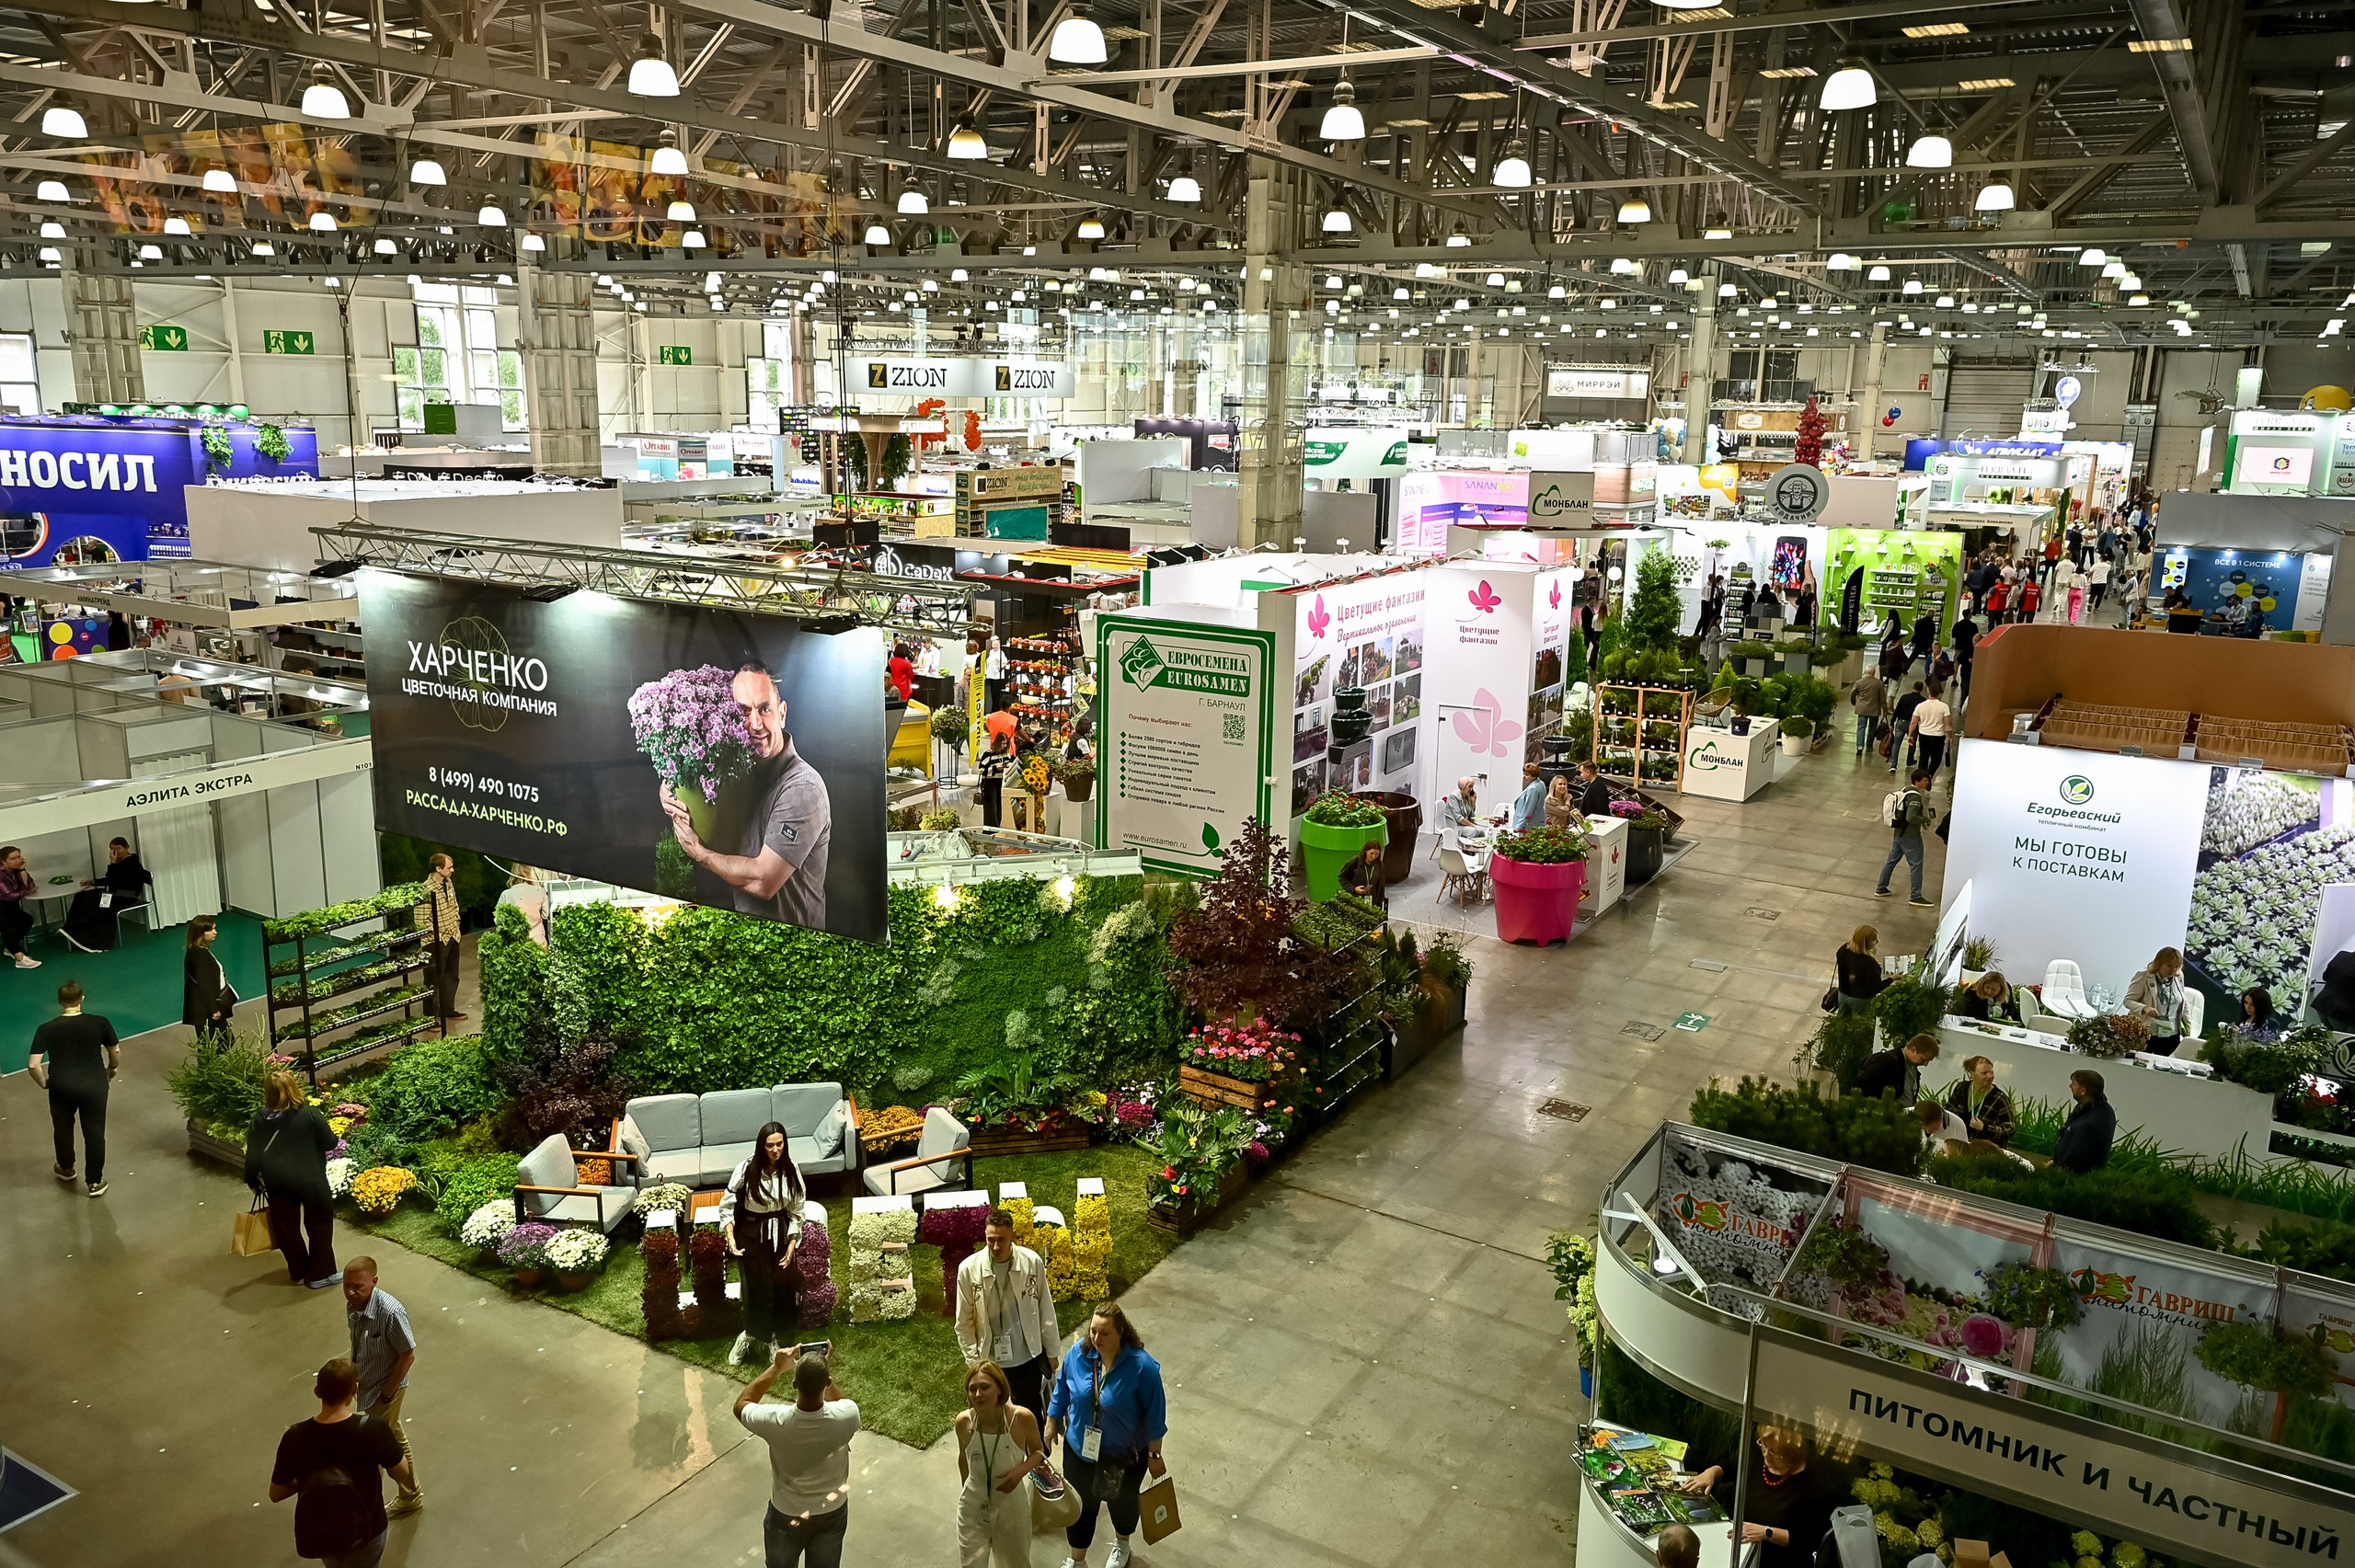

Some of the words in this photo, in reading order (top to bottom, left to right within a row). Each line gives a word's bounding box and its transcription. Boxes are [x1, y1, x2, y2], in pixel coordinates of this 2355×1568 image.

[892, 368, 947, 387] ZION
[1015, 370, 1055, 389] ZION
[1577, 380, 1620, 388] МИРРЭЙ
[0, 449, 157, 493] НОСИЛ
[1544, 499, 1589, 509] МОНБЛАН
[2214, 558, 2230, 567] ВСЕ
[2243, 560, 2281, 568] СИСТЕМЕ
[77, 595, 111, 607] АМИНАТРЕЙД
[1338, 599, 1383, 623] Цветущие
[1385, 589, 1426, 612] фантазии
[1337, 623, 1384, 647] Вертикальное
[1384, 614, 1417, 635] озеленение
[1459, 625, 1499, 635] Цветущие
[1459, 635, 1498, 645] фантазии
[408, 640, 547, 692] ХАРЧЕНКО
[1167, 650, 1247, 672] ЕВРОСЕМЕНА
[1166, 670, 1247, 693] EUROSAMEN
[402, 677, 478, 704] ЦВЕТОЧНАЯ
[482, 691, 557, 717] КОМПАНИЯ
[1199, 698, 1205, 706] Г.
[1207, 698, 1246, 711] БАРНАУЛ
[1129, 714, 1150, 724] Почему
[1150, 717, 1179, 727] выбирают
[1177, 740, 1200, 749] гибридов
[355, 761, 373, 771] N101
[1147, 753, 1169, 761] мировые
[1170, 757, 1200, 765] поставщики
[1148, 762, 1170, 771] контроль
[1700, 753, 1743, 767] МОНБЛАН
[126, 786, 190, 808] АЭЛИТА
[194, 773, 253, 795] ЭКСТРА
[429, 767, 437, 782] 8
[441, 767, 475, 793] (499)
[477, 777, 504, 795] 490
[507, 782, 539, 802] 1075
[1128, 776, 1169, 787] Индивидуальный
[406, 789, 568, 837] РАССАДА-ХАРЧЕНКО.РФ
[1127, 793, 1150, 802] Отправка
[1207, 806, 1224, 814] России
[2027, 802, 2121, 824] Егорьевский
[2038, 818, 2074, 829] тепличный
[2074, 822, 2107, 832] комбинат
[1122, 831, 1188, 849] www.eurosamen.ru
[2015, 836, 2045, 853] МЫ
[2052, 841, 2127, 864] ГОТОВЫ
[2012, 856, 2022, 868] К
[2028, 858, 2124, 883] ПОСТАВКАМ
[2137, 1286, 2235, 1323] ГАВРИШ
[2318, 1312, 2352, 1328] ГАВРИШ
[1848, 1388, 2067, 1478] ПИТОМНИК
[2083, 1461, 2110, 1492] И
[2126, 1475, 2339, 1561] ЧАСТНЫЙ
